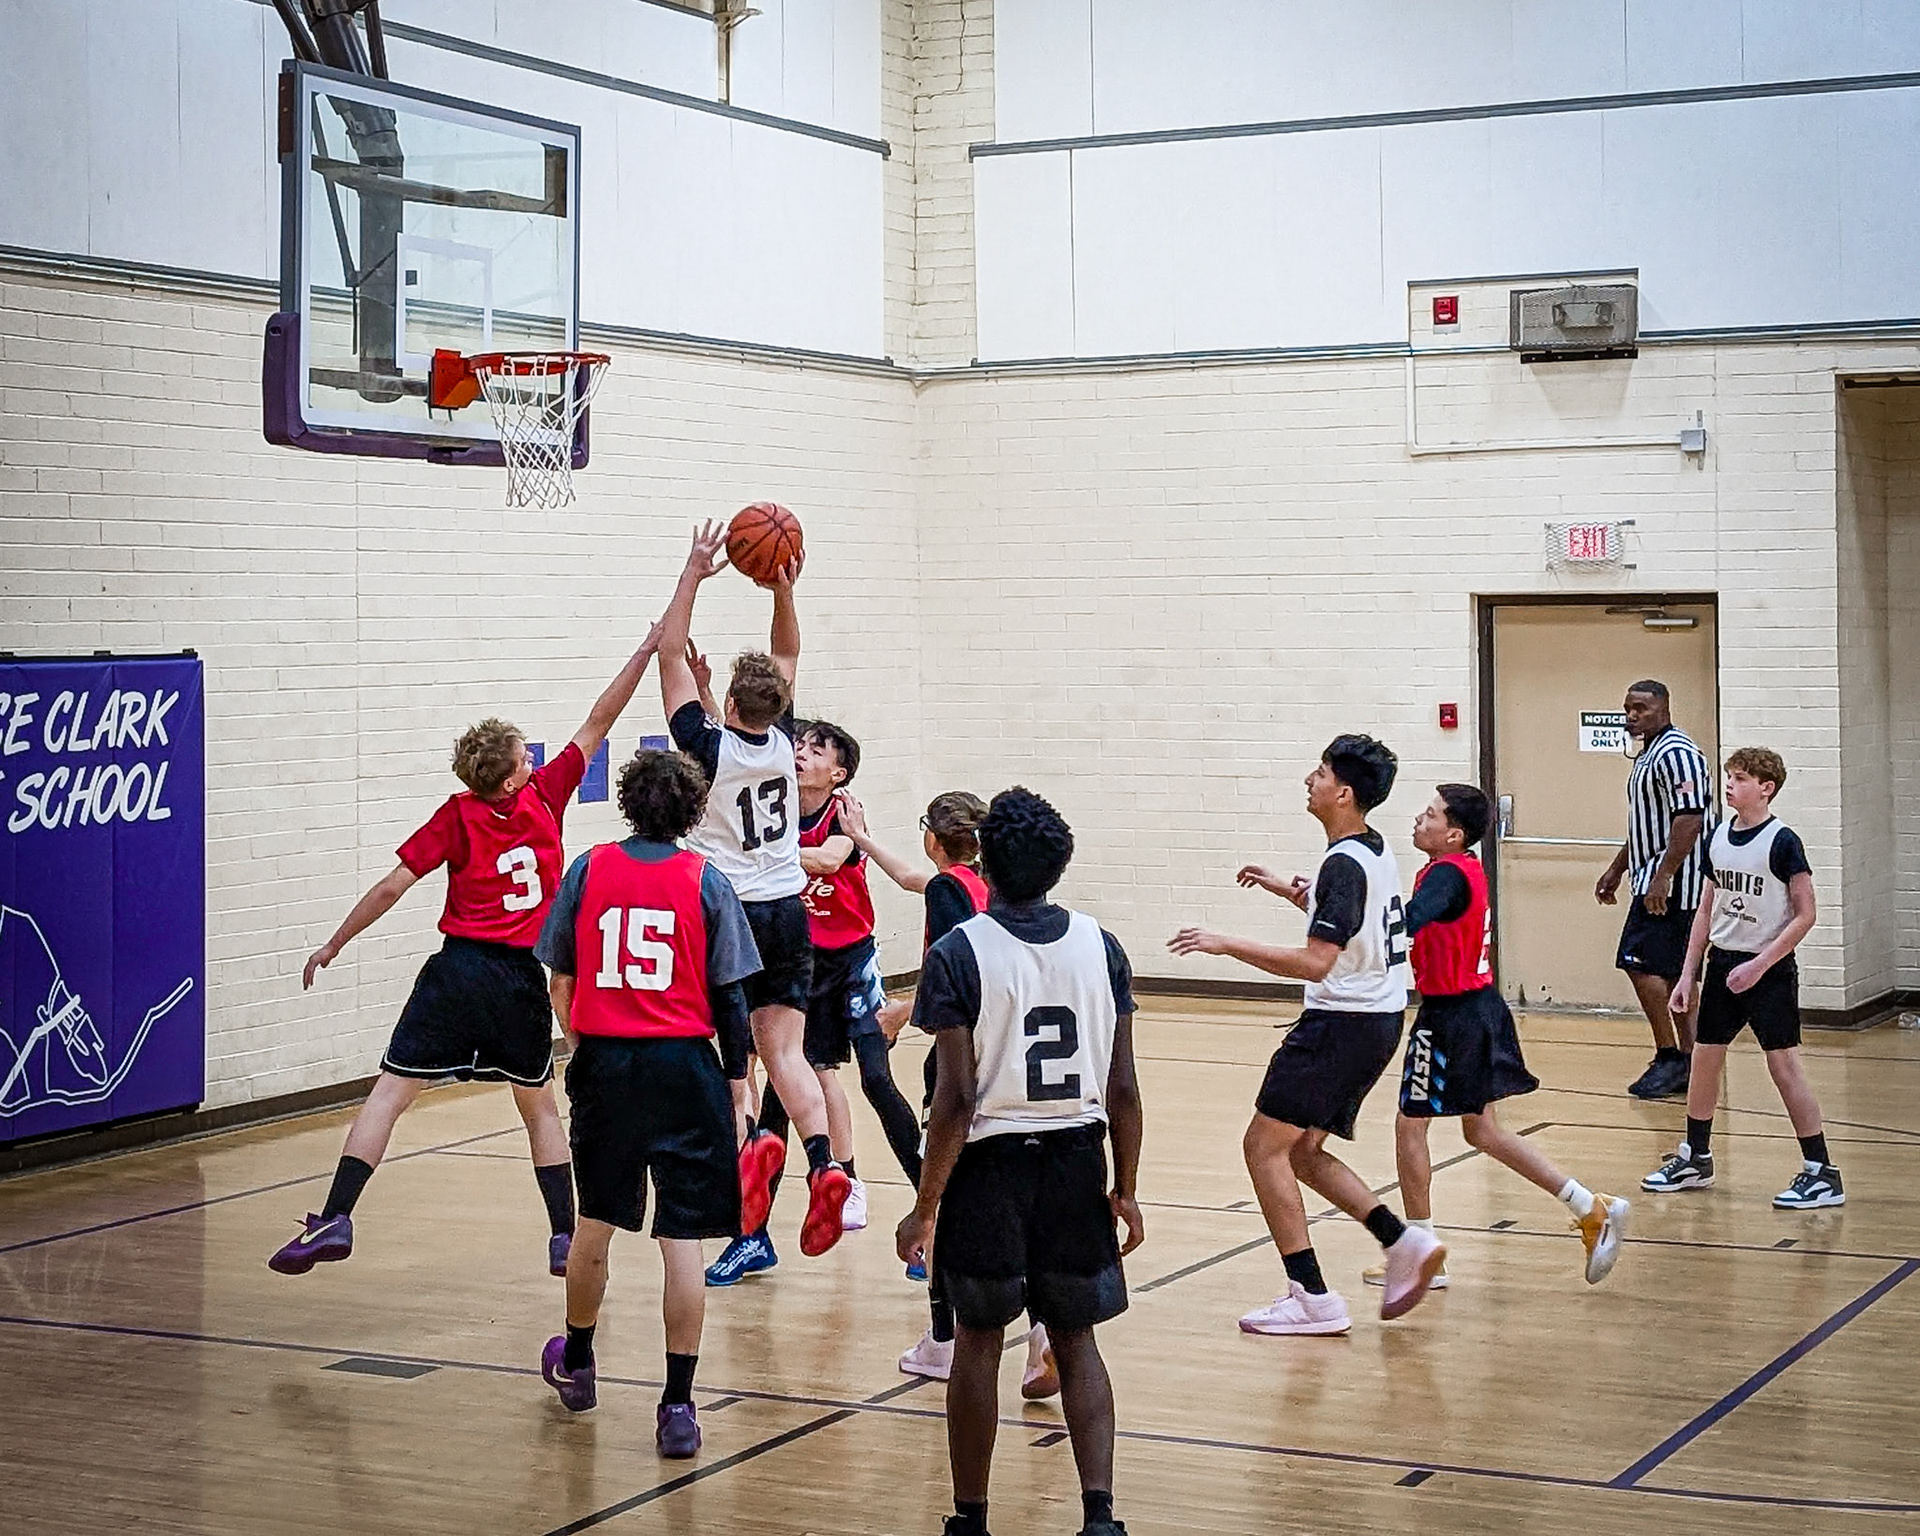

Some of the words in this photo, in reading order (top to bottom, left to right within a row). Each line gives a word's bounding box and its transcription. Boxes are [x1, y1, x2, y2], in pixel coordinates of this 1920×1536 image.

[1569, 526, 1608, 557] EXIT
[44, 689, 179, 753] CLARK
[1584, 715, 1627, 724] NOTICE
[1591, 739, 1620, 747] ONLY
[1593, 730, 1619, 738] EXIT
[8, 761, 171, 833] SCHOOL
[736, 775, 787, 851] 13
[496, 845, 543, 911] 3
[595, 907, 675, 991] 15
[1024, 1005, 1081, 1101] 2
[1409, 1029, 1433, 1101] VISTA
